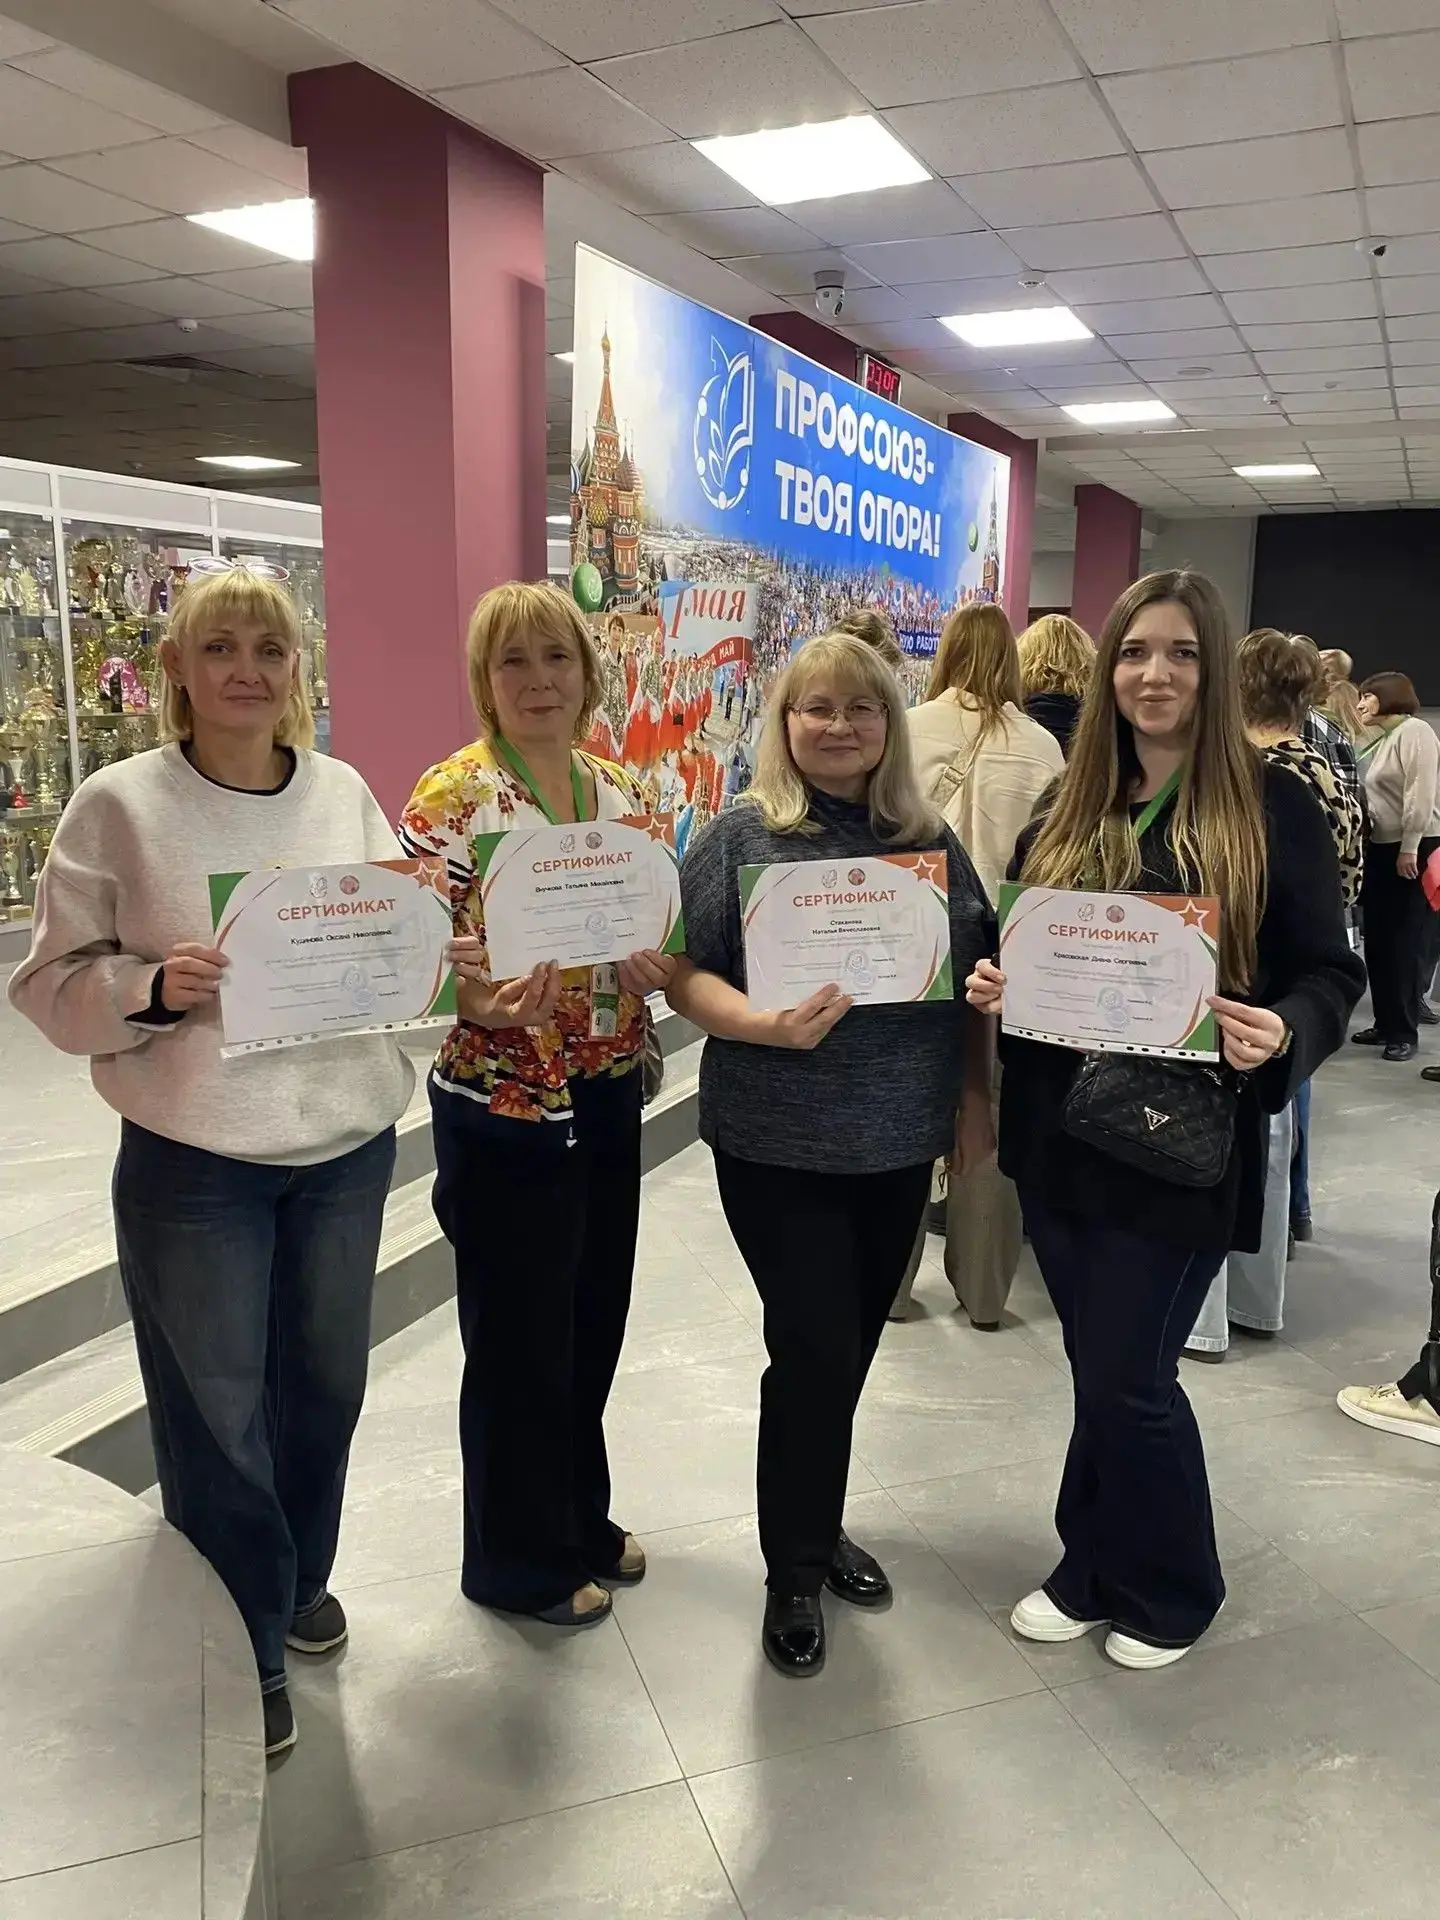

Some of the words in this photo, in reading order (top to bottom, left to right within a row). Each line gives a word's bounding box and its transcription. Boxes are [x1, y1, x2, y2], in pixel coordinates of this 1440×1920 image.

[775, 368, 935, 485] ПРОФСОЮЗ-
[774, 459, 853, 537] ТВОЯ
[858, 489, 942, 558] ОПОРА!
[532, 851, 633, 874] СЕРТИФИКАТ
[277, 898, 397, 921] СЕРТИФИКАТ
[792, 889, 897, 908] СЕРТИФИКАТ
[1047, 923, 1159, 944] СЕРТИФИКАТ
